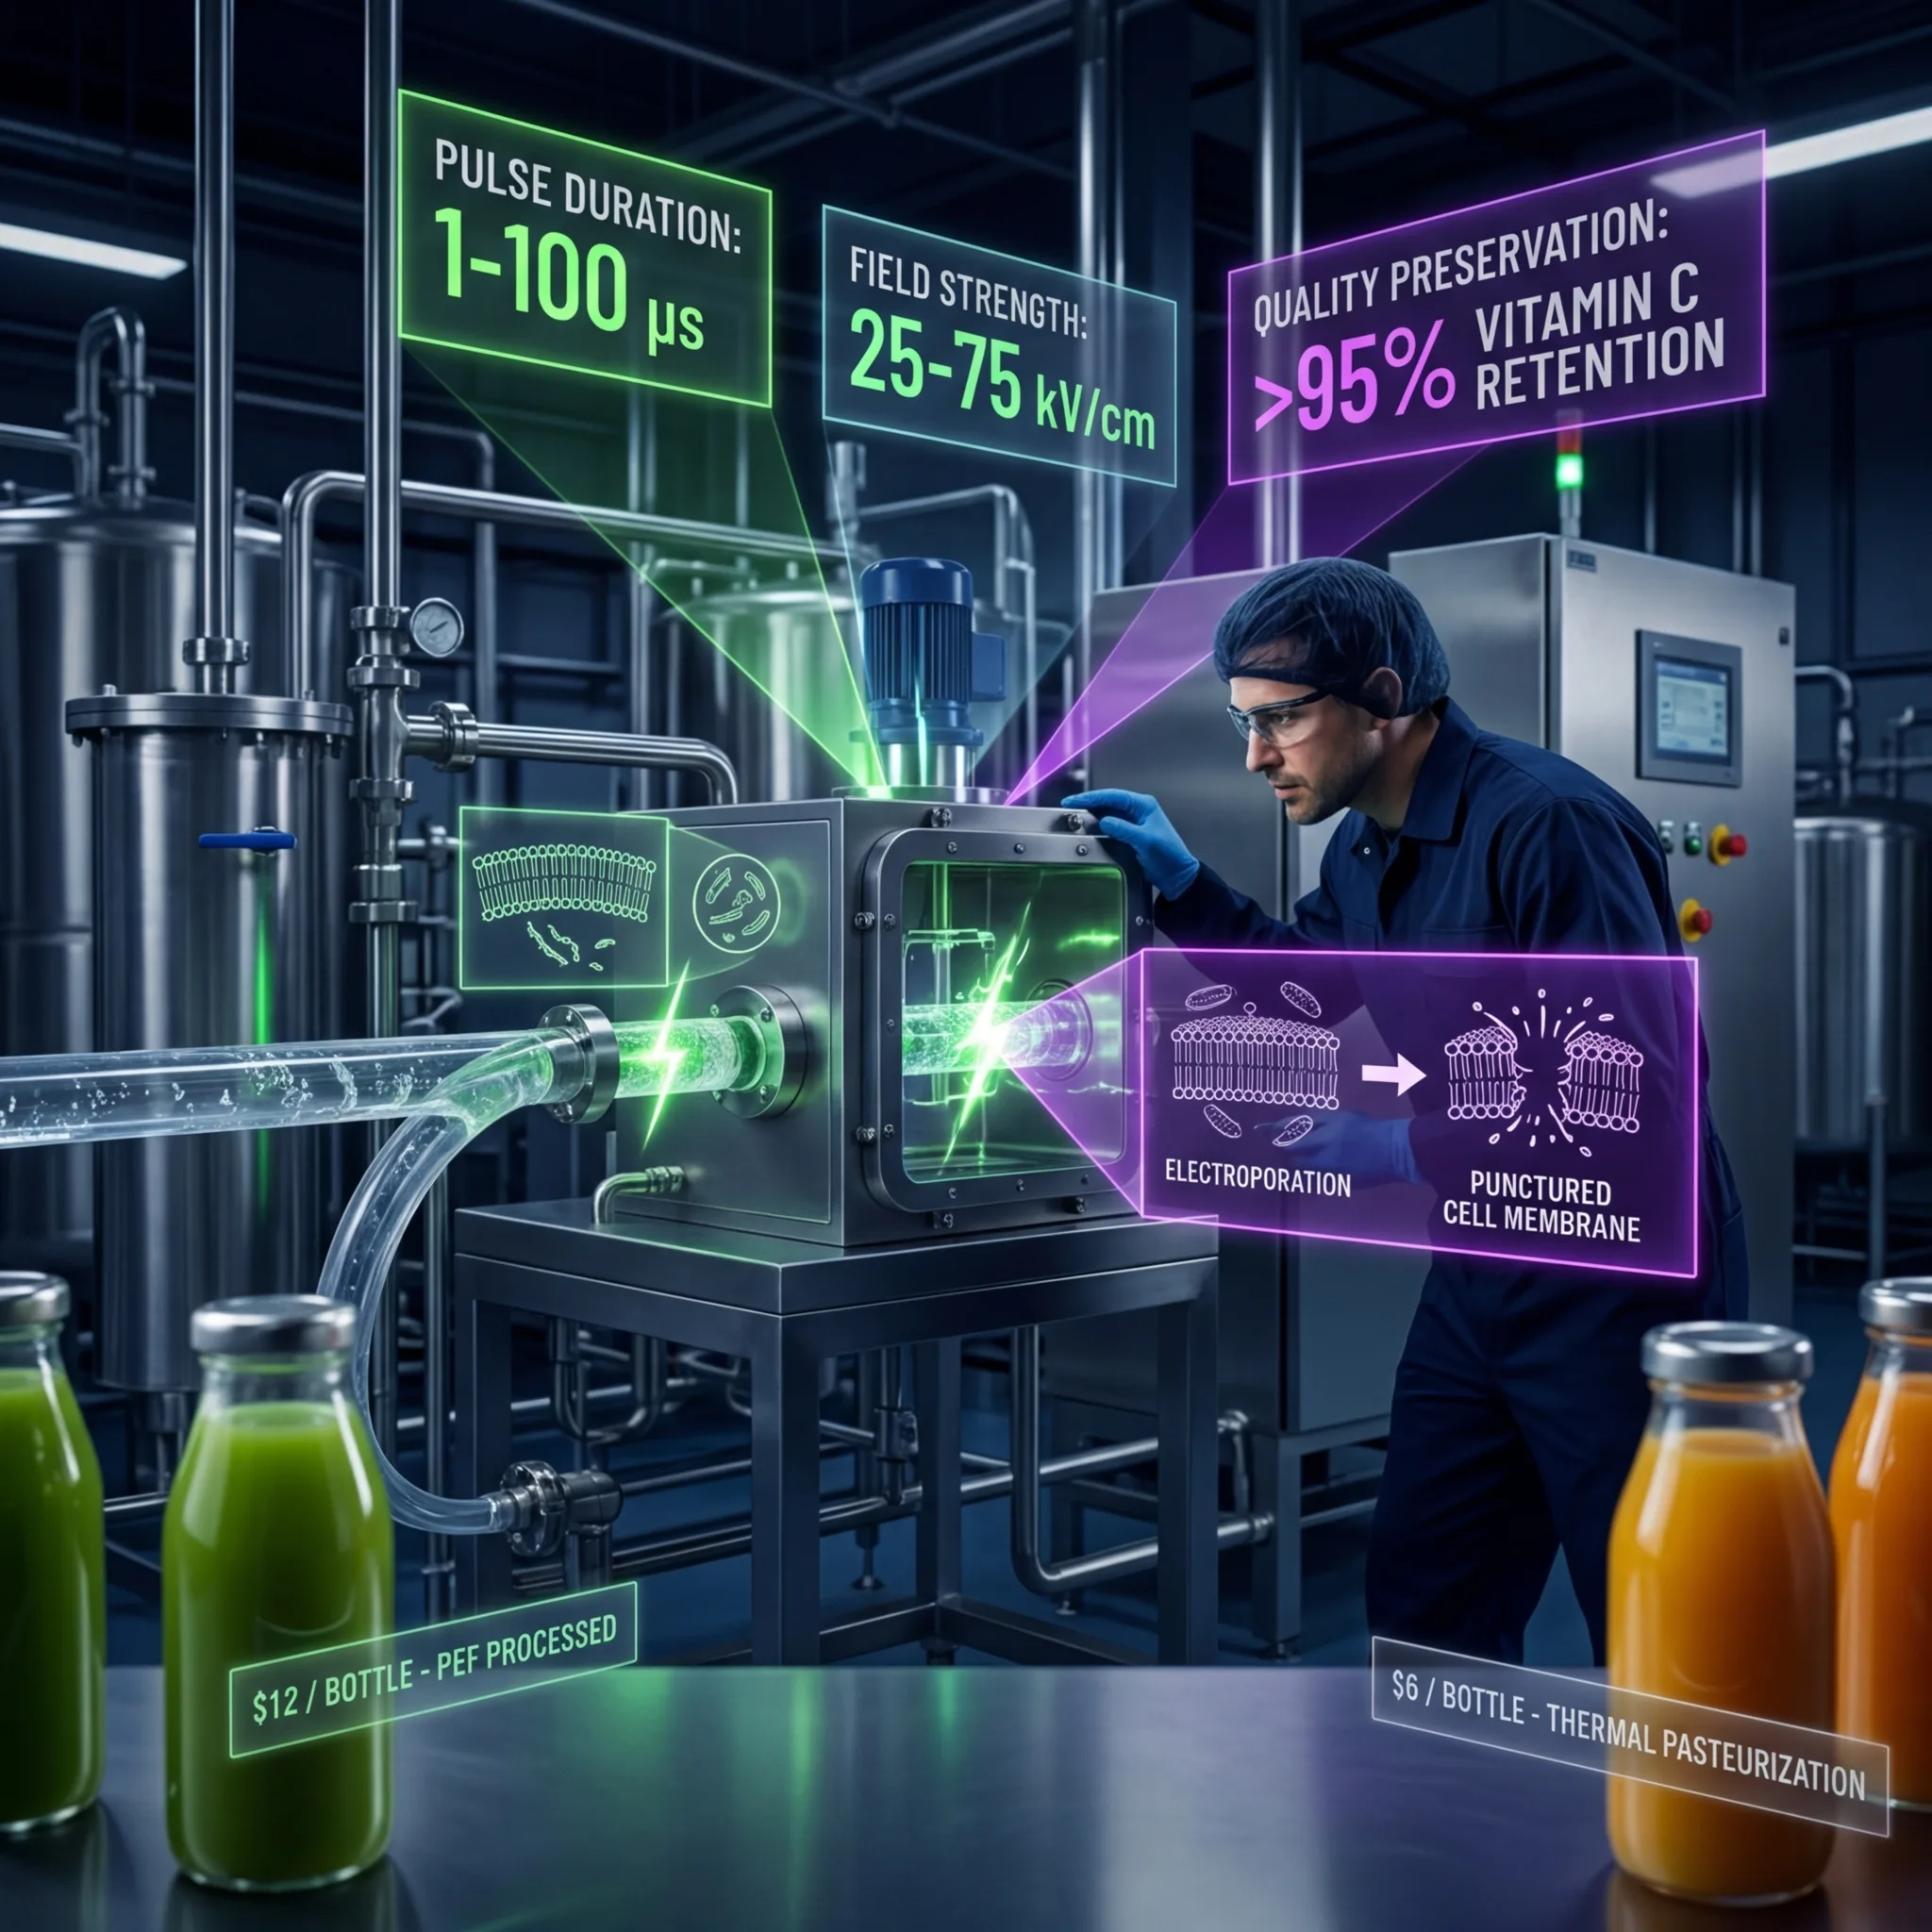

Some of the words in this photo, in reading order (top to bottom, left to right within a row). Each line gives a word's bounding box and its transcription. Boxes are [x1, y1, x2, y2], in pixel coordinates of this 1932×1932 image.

[436, 138, 551, 207] PULSE
[566, 173, 742, 254] DURATION:
[435, 208, 626, 332] 1-100
[649, 298, 704, 357] µs
[852, 245, 930, 299] FIELD
[941, 270, 1088, 340] STRENGTH:
[1254, 267, 1378, 338] QUALITY
[1391, 198, 1669, 301] PRESERVATION:
[1475, 271, 1652, 353] VITAMIN
[1671, 262, 1699, 313] C
[851, 308, 1021, 419] 25-75
[1037, 374, 1156, 450] kV/cm
[1255, 319, 1456, 432] >95%
[1476, 318, 1724, 410] RETENTION
[1165, 1158, 1351, 1198] ELECTROPORATION
[1443, 1199, 1503, 1229] CELL
[1504, 1205, 1641, 1242] MEMBRANE
[1471, 1170, 1611, 1207] PUNCTURED
[253, 1686, 298, 1725] $12
[306, 1680, 317, 1713] /
[325, 1659, 413, 1707] BOTTLE
[438, 1644, 479, 1680] PEF
[487, 1614, 617, 1669] PROCESSED
[1392, 1669, 1419, 1702] $6
[1425, 1677, 1436, 1707] /
[1443, 1681, 1524, 1724] BOTTLE
[1547, 1704, 1656, 1755] THERMAL
[1663, 1728, 1866, 1801] PASTEURIZATION
